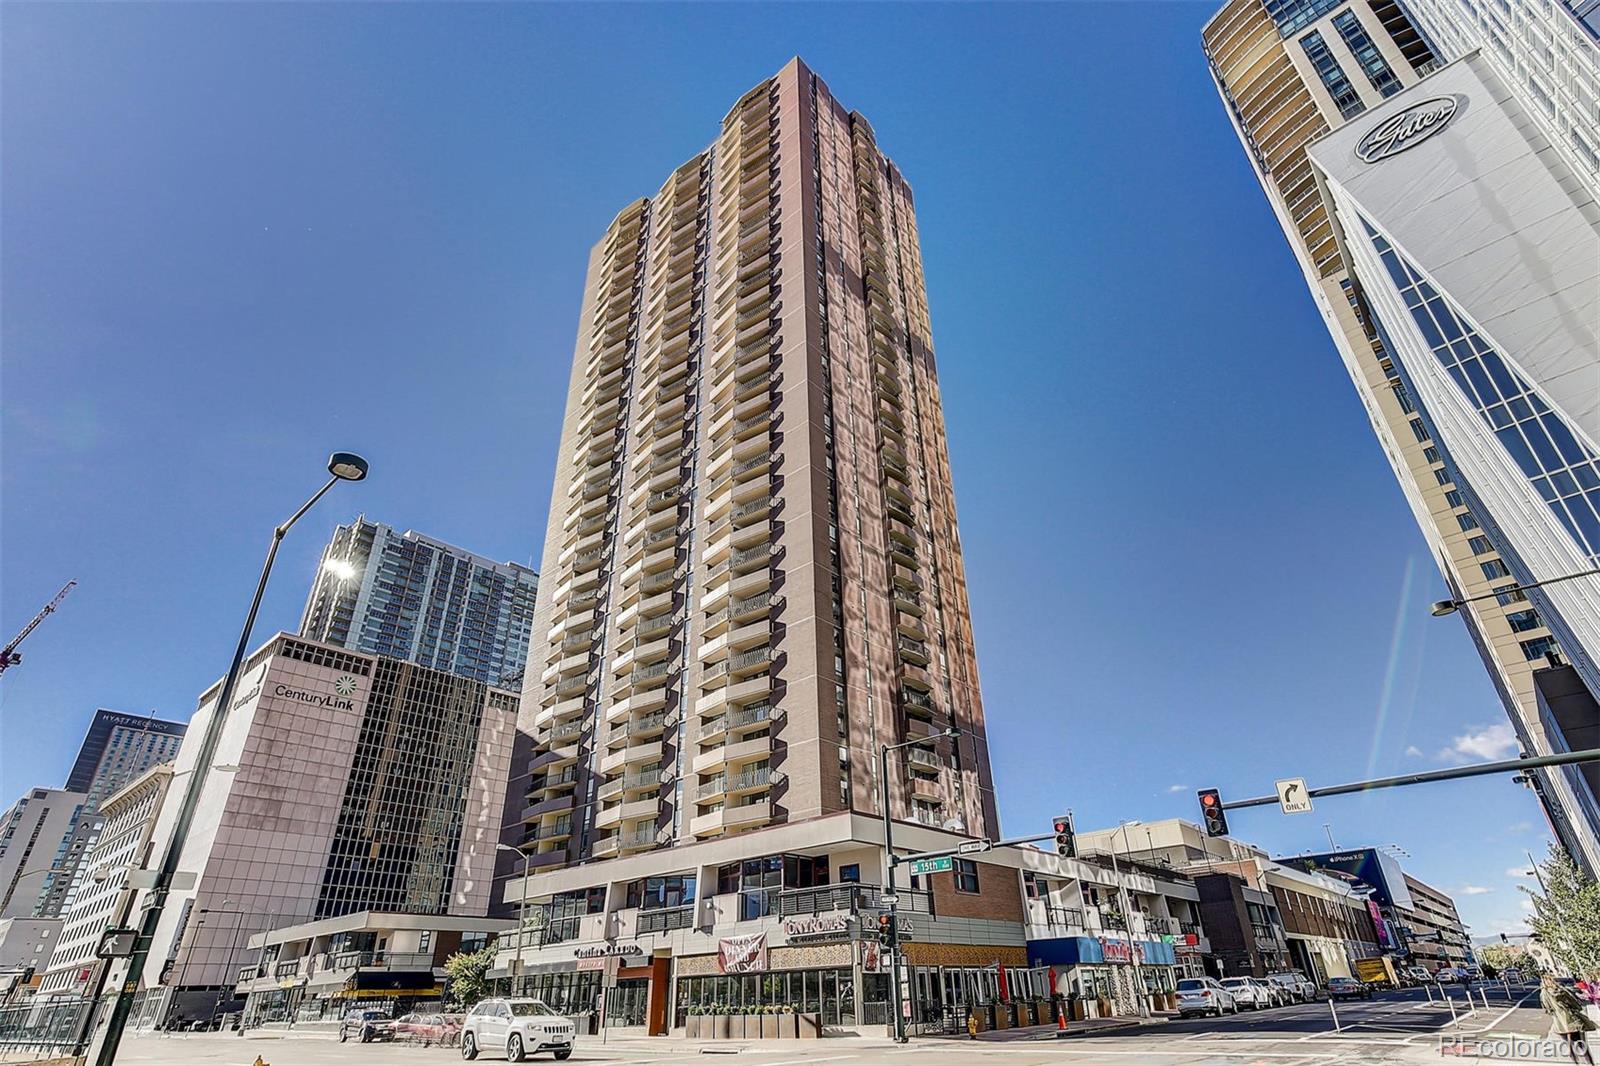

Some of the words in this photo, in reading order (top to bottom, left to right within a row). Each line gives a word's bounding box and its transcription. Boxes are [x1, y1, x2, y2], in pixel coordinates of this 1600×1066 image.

[1366, 106, 1452, 155] Gates
[275, 685, 354, 711] CenturyLink
[102, 715, 130, 725] HYATT
[132, 720, 168, 730] REGNCY
[1285, 802, 1306, 811] ONLY
[921, 862, 938, 871] 15th
